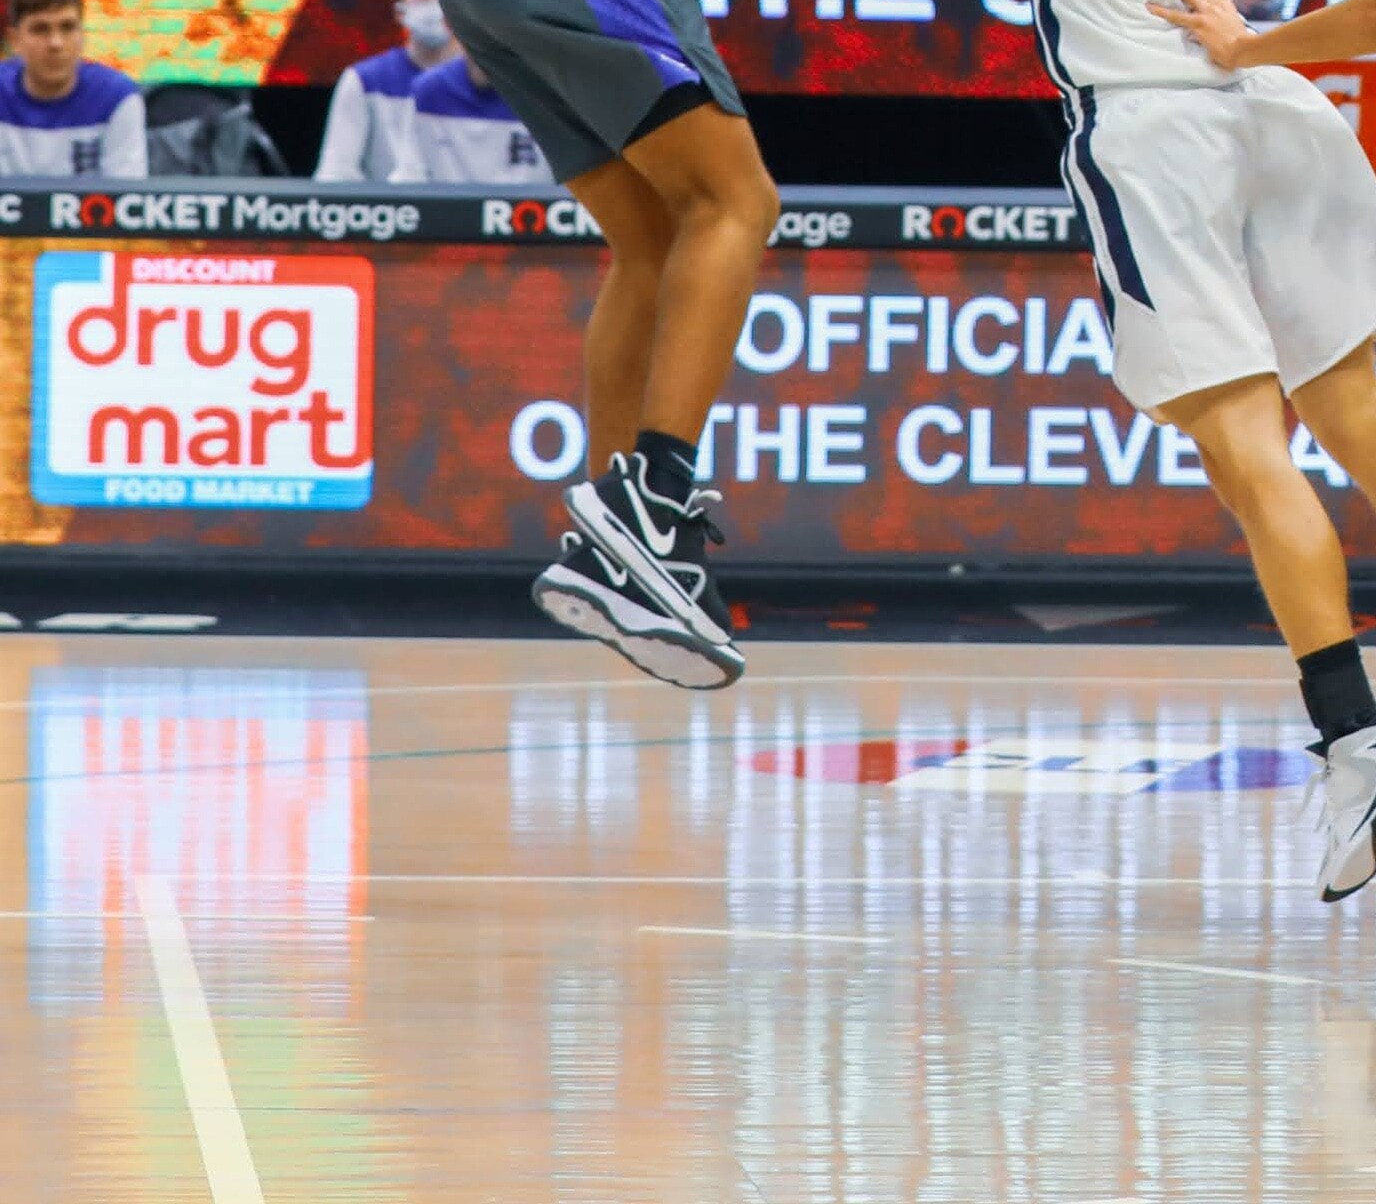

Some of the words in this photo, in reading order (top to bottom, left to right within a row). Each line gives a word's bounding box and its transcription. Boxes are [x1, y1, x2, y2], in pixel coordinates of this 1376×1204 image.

[50, 193, 230, 230] ROCKET
[233, 194, 421, 241] Mortgage
[902, 204, 1077, 242] ROCKET
[131, 257, 277, 283] DISCOUNT
[67, 258, 311, 396] drug
[734, 293, 1116, 376] OFFICIA
[87, 390, 366, 469] mart
[105, 478, 187, 503] FOOD
[190, 479, 315, 505] MARKET
